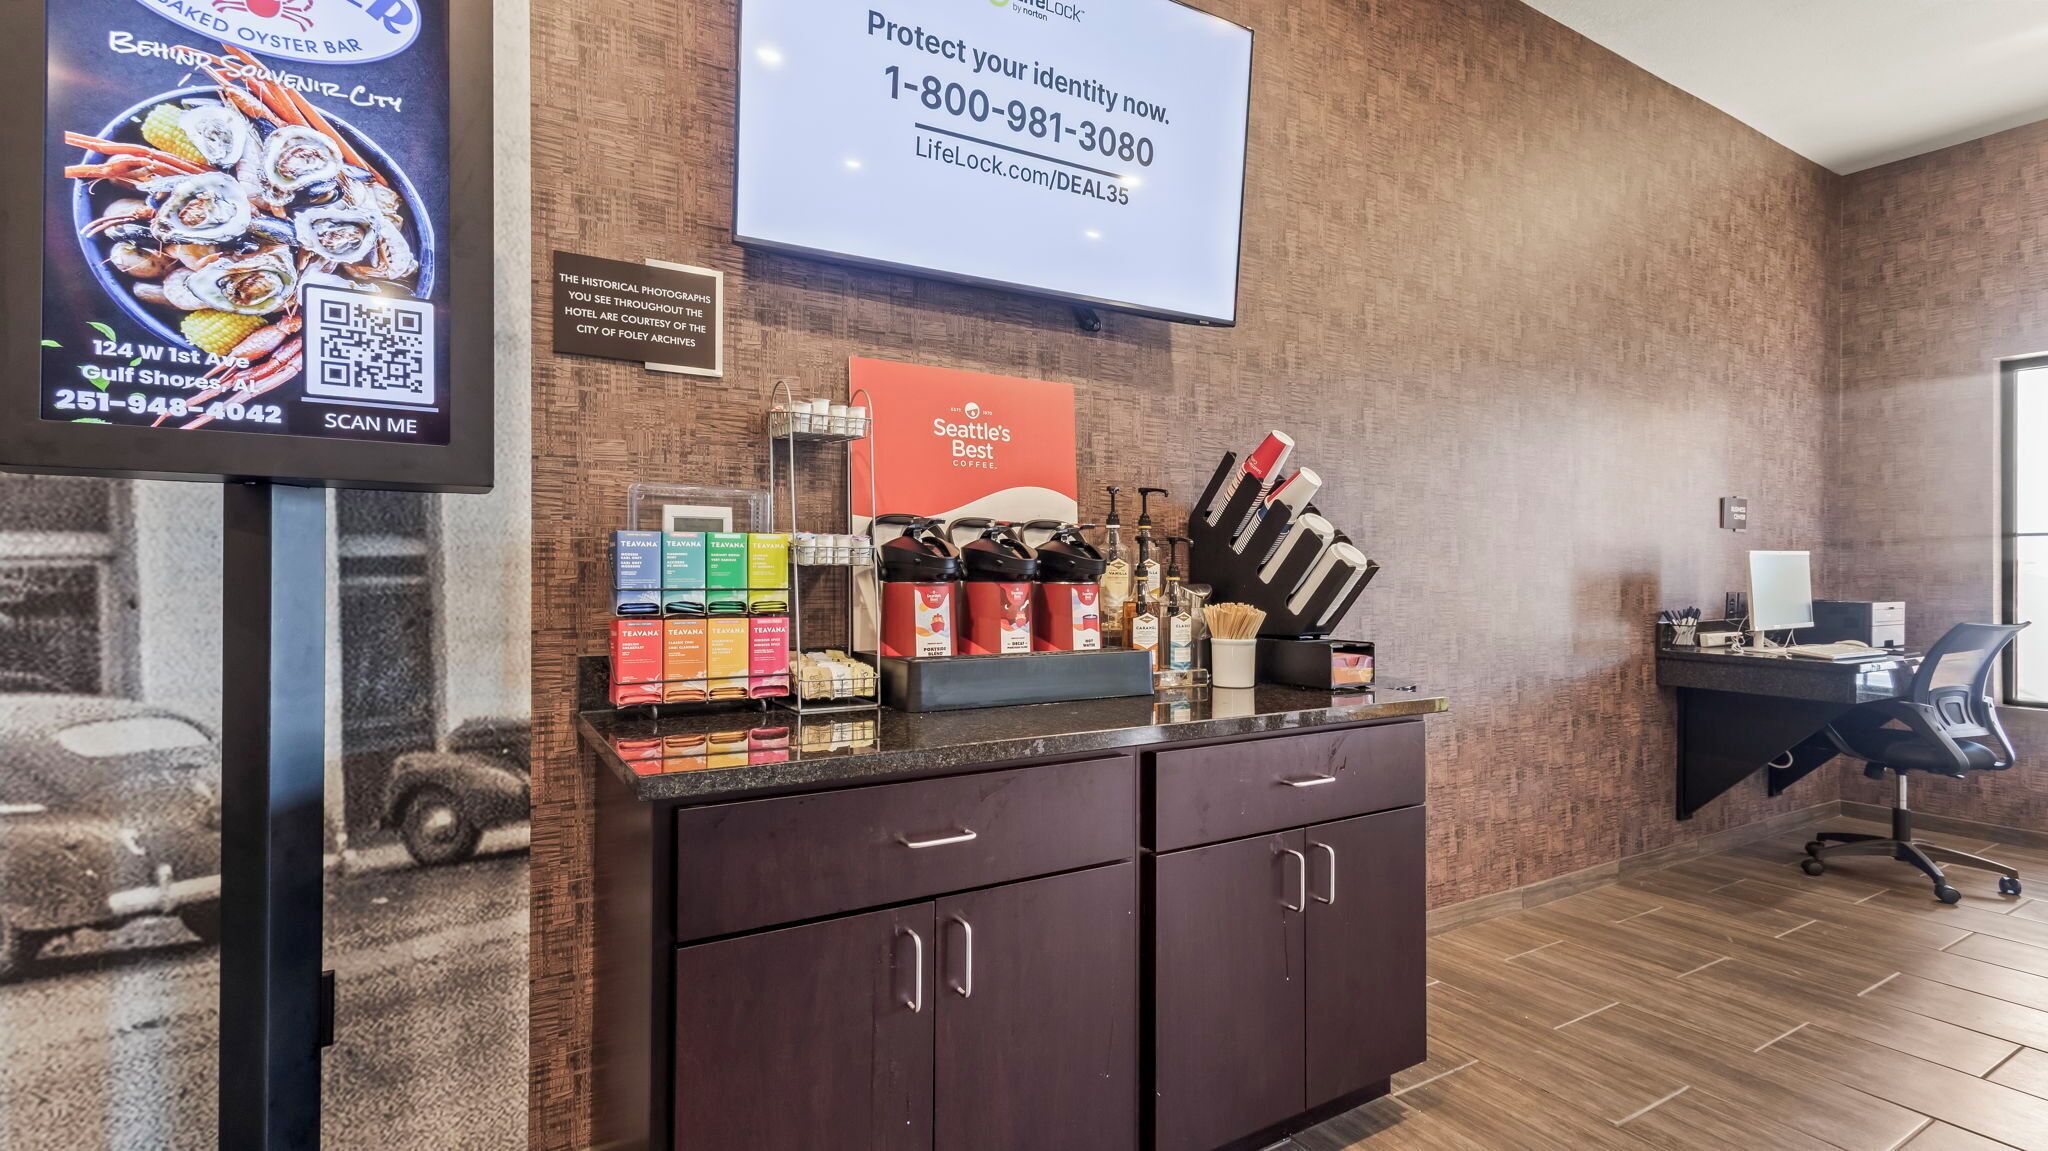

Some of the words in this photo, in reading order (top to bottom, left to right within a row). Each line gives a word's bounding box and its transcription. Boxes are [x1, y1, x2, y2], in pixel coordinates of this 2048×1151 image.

[1012, 2, 1022, 14] by
[1022, 7, 1048, 21] norton
[237, 27, 318, 54] OYSTER
[323, 38, 363, 54] BAR
[866, 10, 967, 64] Protect
[972, 47, 1028, 81] your
[1033, 61, 1118, 113] identity
[1123, 95, 1170, 125] now.
[885, 65, 1154, 167] 1-800-981-3080
[915, 136, 1129, 206] LifeLock.com/DEAL35
[559, 272, 579, 284] THE
[581, 276, 640, 293] HISTORICAL
[641, 285, 711, 304] PHOTOGRAPHS
[568, 290, 592, 302] YOU
[594, 294, 612, 305] SEE
[613, 297, 684, 315] THROUGHOUT
[685, 307, 703, 318] THE
[564, 306, 598, 319] HOTEL
[599, 311, 619, 322] ARE
[620, 314, 671, 328] COURTESY
[673, 321, 687, 331] OF
[689, 323, 707, 334] THE
[576, 324, 599, 335] CITY
[601, 327, 616, 337] OF
[618, 329, 649, 341] FOLEY
[650, 334, 696, 347] ARCHIVES
[92, 340, 133, 358] 124
[138, 344, 164, 361] W
[168, 347, 200, 364] 1st
[204, 352, 250, 369] Ave
[81, 365, 135, 383] Gulf
[138, 369, 225, 393] Shores,
[55, 389, 282, 424] 251-948-4042
[324, 413, 381, 432] SCAN
[387, 417, 417, 434] ME
[933, 417, 1011, 442] Seattle's
[952, 439, 994, 460] Best
[952, 460, 995, 469] COFFEE
[620, 540, 658, 548] TEAVANA
